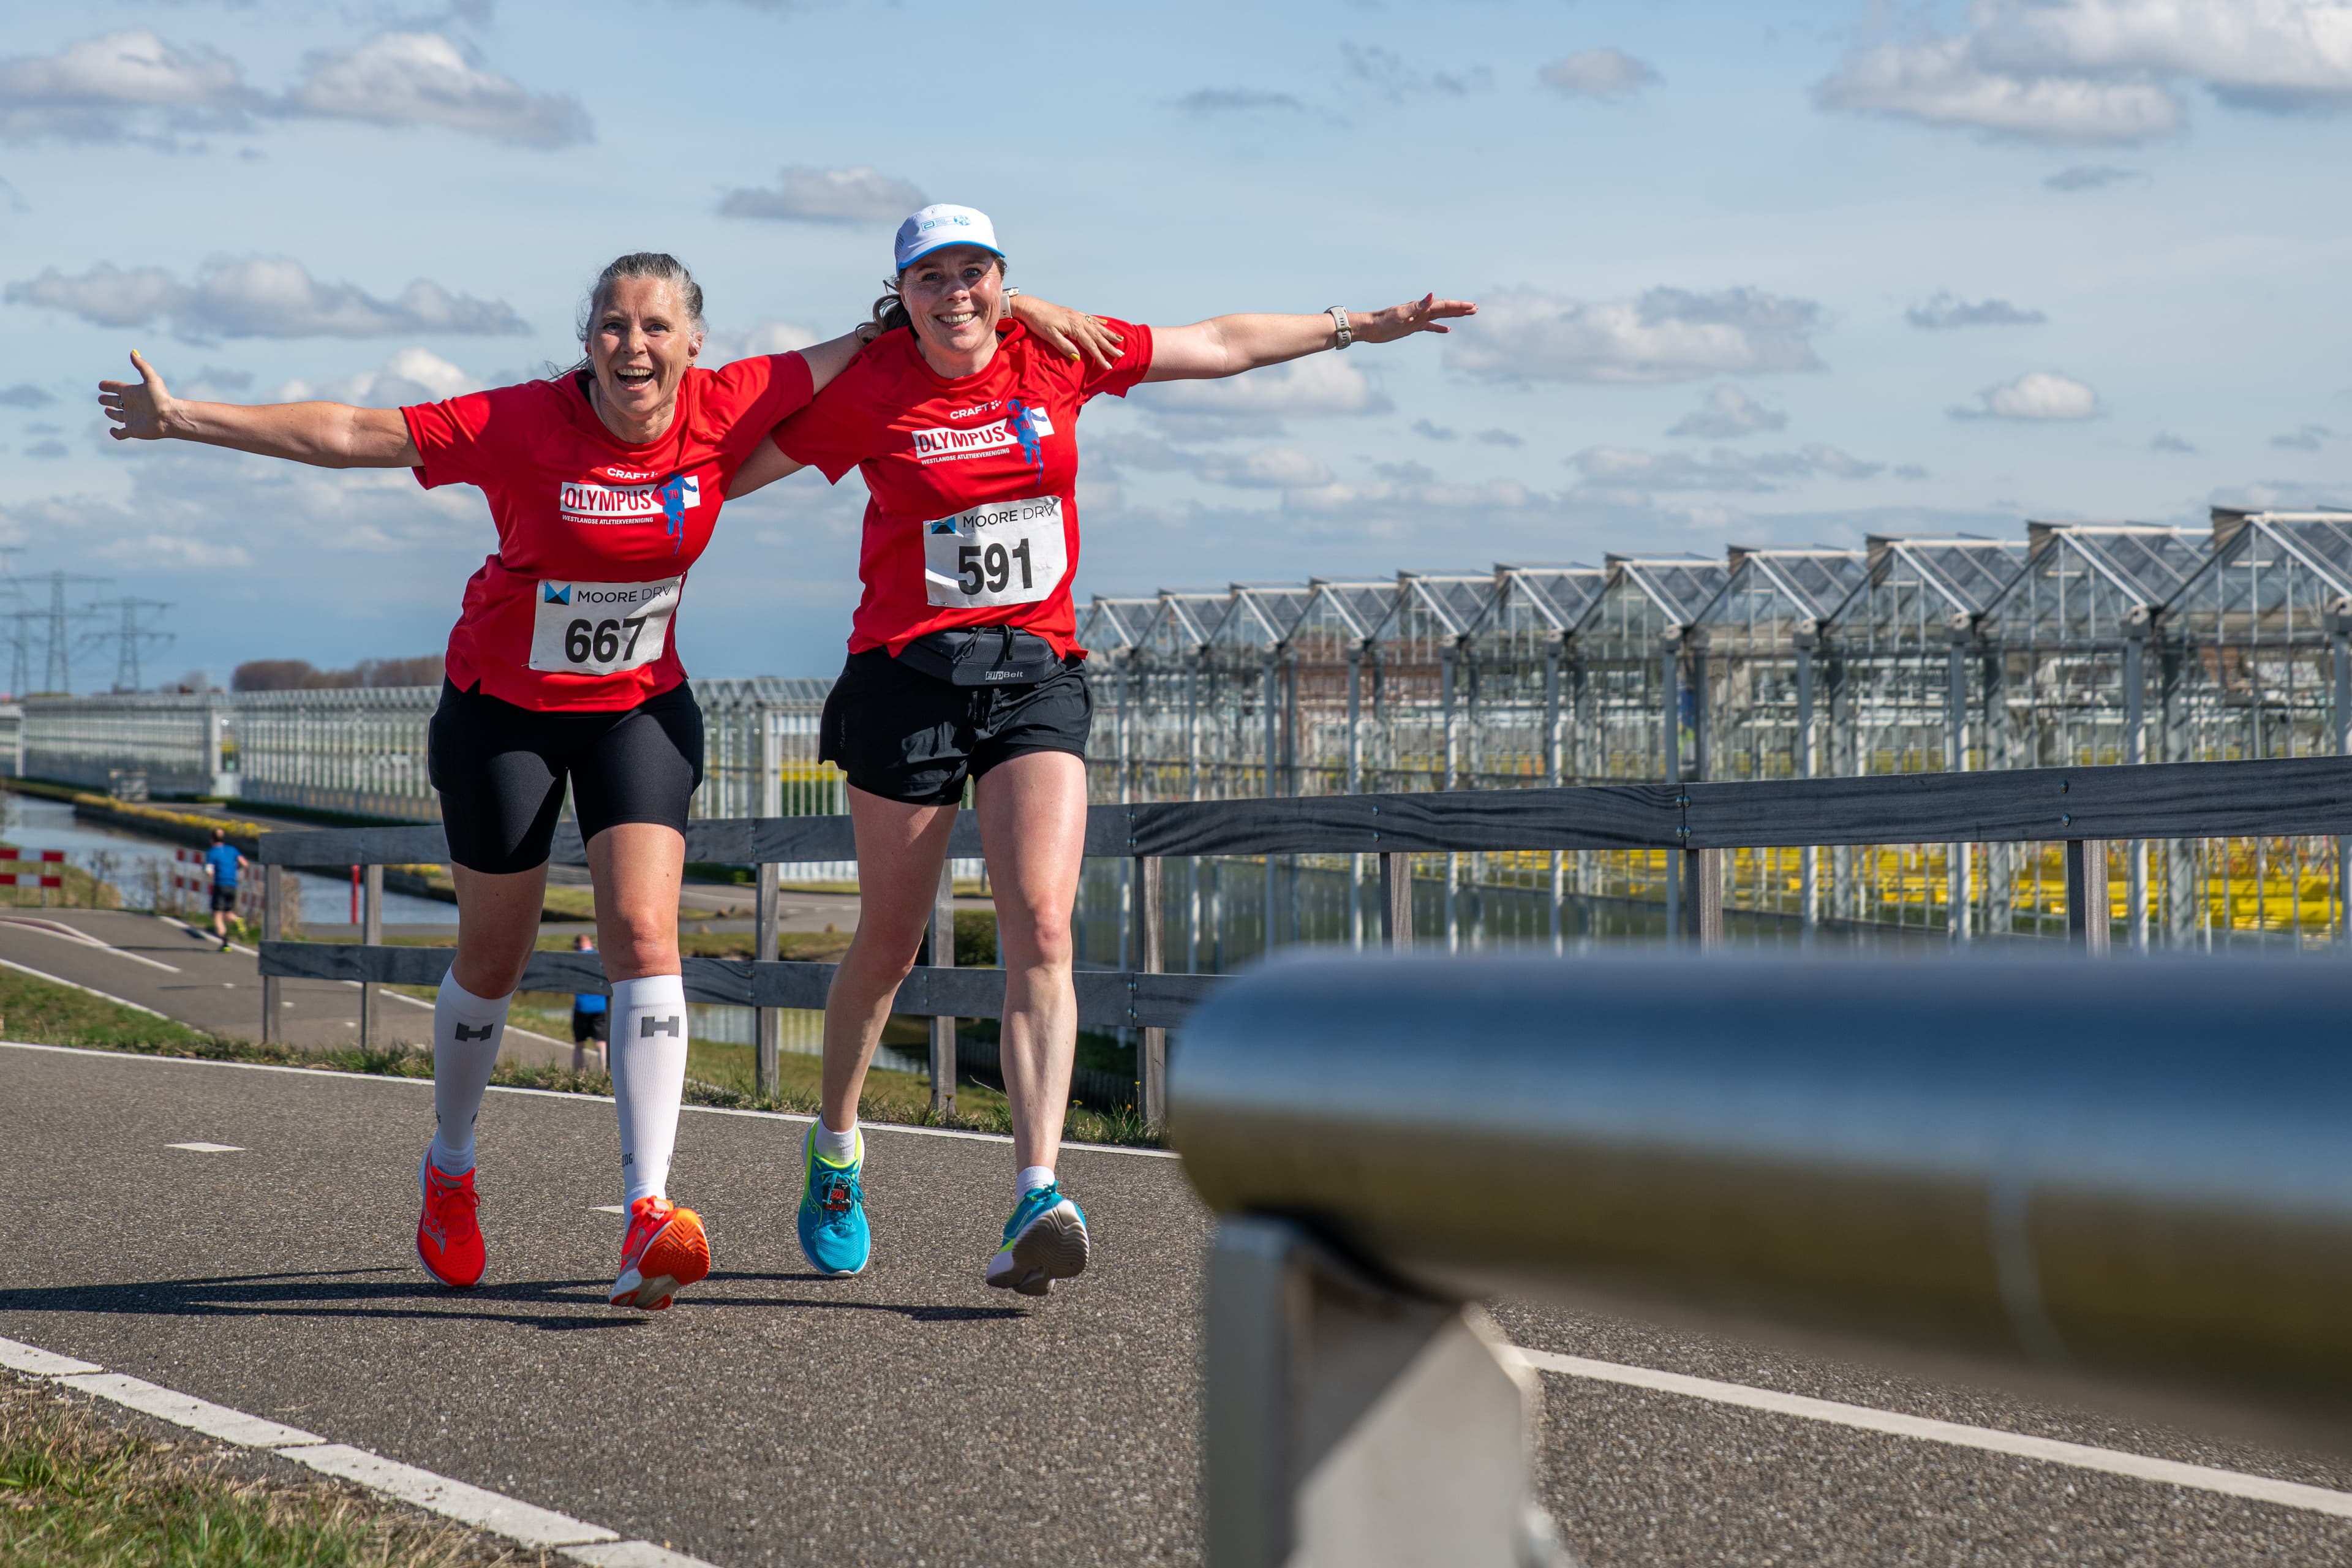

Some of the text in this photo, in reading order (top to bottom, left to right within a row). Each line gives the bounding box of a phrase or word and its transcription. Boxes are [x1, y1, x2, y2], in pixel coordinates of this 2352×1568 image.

[949, 402, 989, 419] CRAFT
[1020, 420, 1030, 431] 70
[918, 426, 1006, 453] OLYMPUS
[921, 447, 1010, 465] WESTLANDSE ATLETIEKVERENIGING
[606, 467, 649, 480] CRAFT
[564, 488, 651, 511] OLYMPUS
[666, 489, 679, 500] 70
[562, 514, 654, 526] WESTLANDSE ATLETIEKVERENIGING
[962, 503, 1055, 529] MOORE DRV
[958, 538, 1033, 595] 591
[577, 584, 674, 603] MOORE DRV
[565, 615, 647, 663] 667
[985, 670, 1024, 680] FlipBelt
